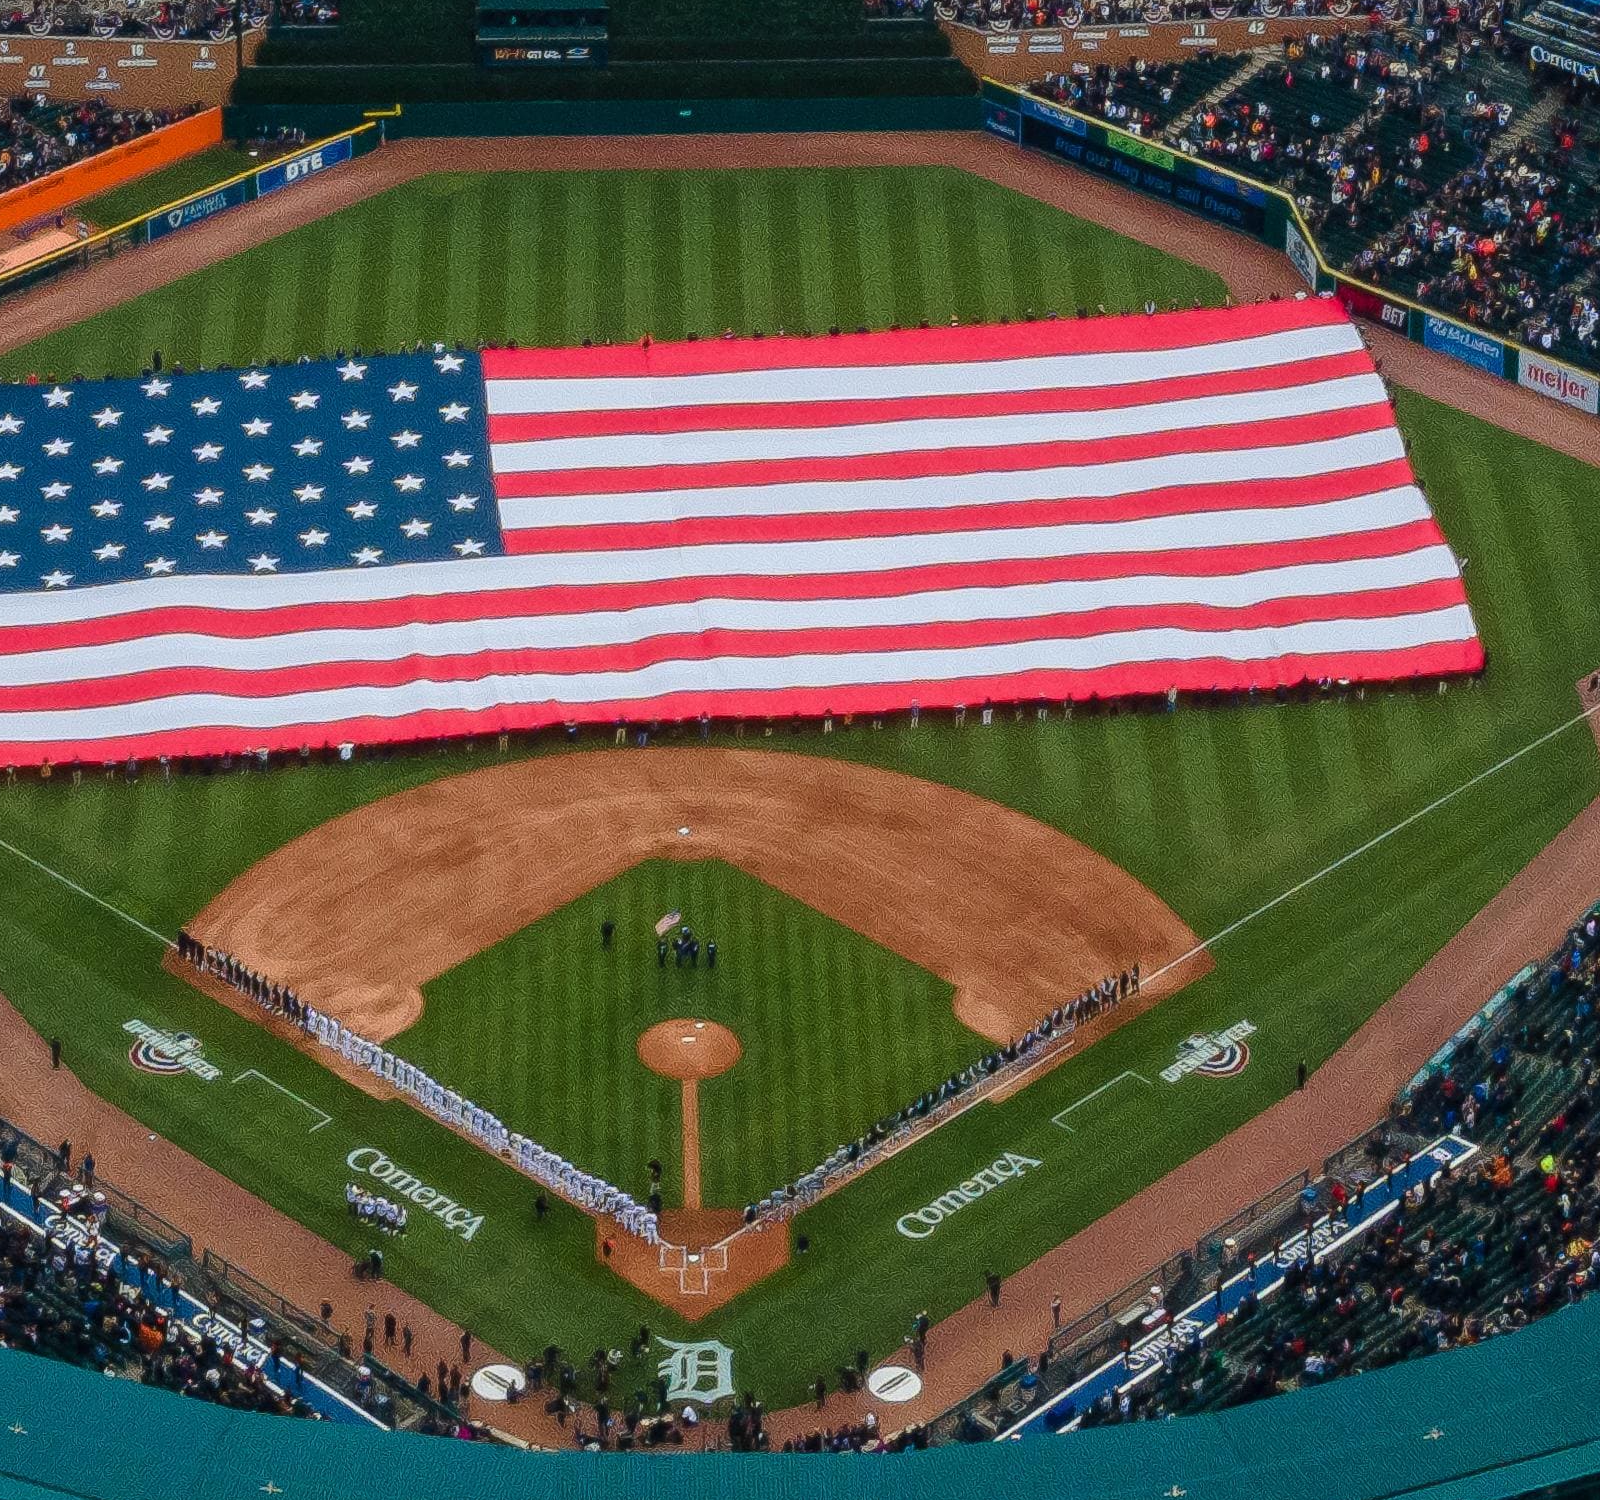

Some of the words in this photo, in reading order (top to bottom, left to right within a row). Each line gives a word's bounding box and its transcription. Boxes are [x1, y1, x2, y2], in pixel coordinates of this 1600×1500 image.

[286, 152, 324, 181] DTE
[1527, 360, 1589, 401] meijer
[655, 1336, 736, 1404] D
